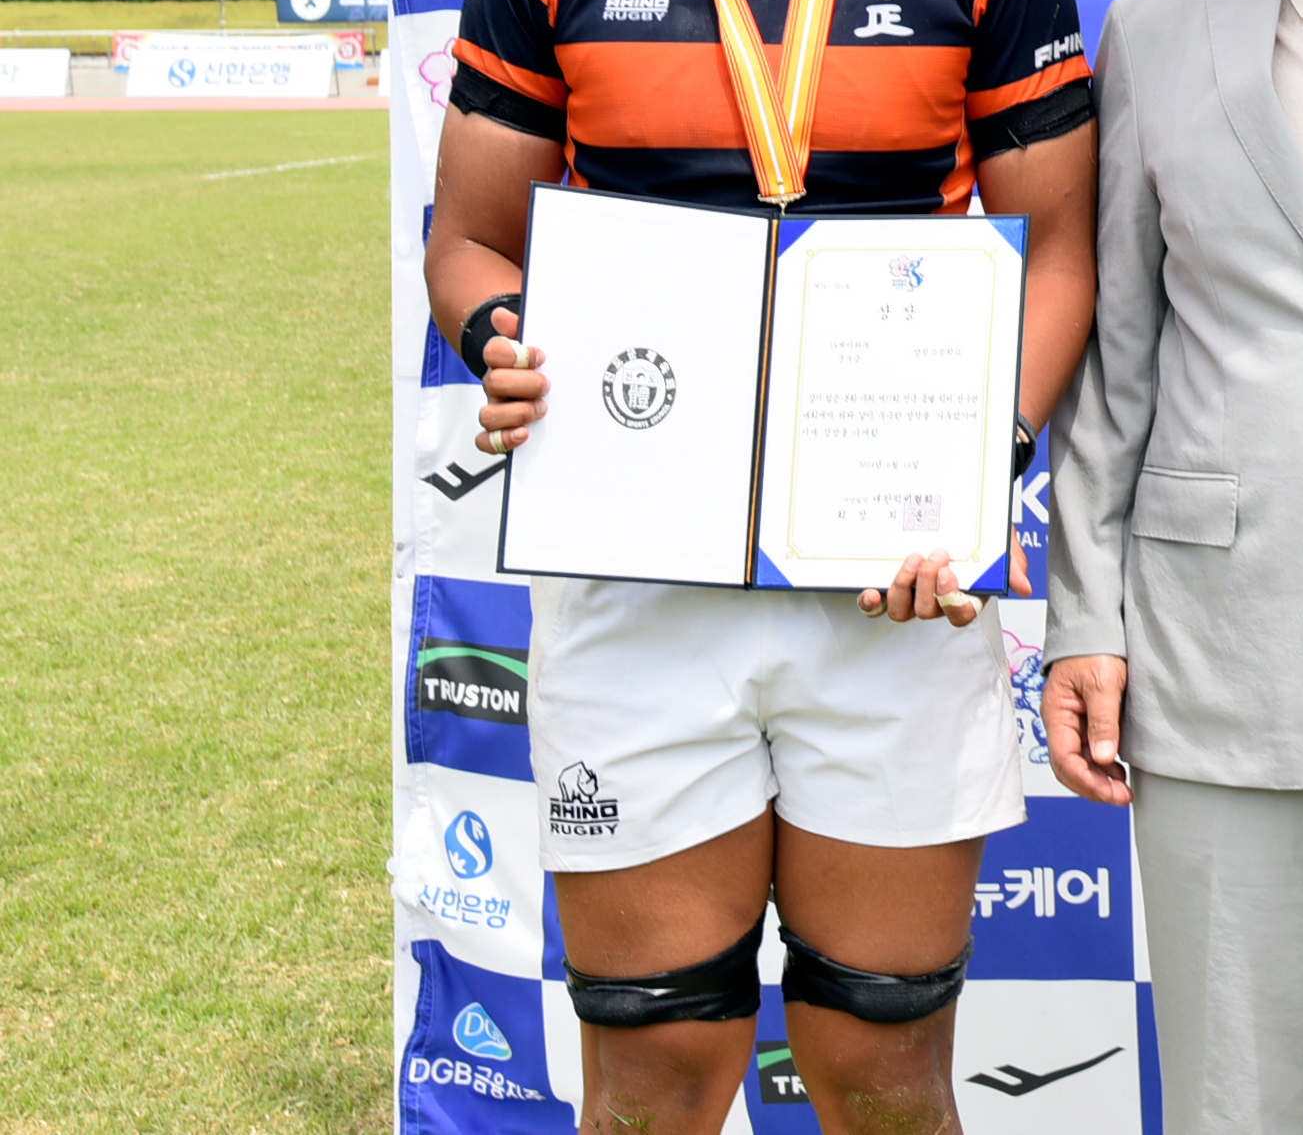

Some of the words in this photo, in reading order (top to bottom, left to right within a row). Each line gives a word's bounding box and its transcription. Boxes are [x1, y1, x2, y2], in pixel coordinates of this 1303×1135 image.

[602, 10, 667, 22] RUGBY
[204, 62, 291, 85] 신한은행
[424, 677, 520, 714] TRUSTON
[550, 803, 618, 819] RHINO
[550, 822, 620, 836] RUGBY
[418, 884, 511, 929] 신한은행
